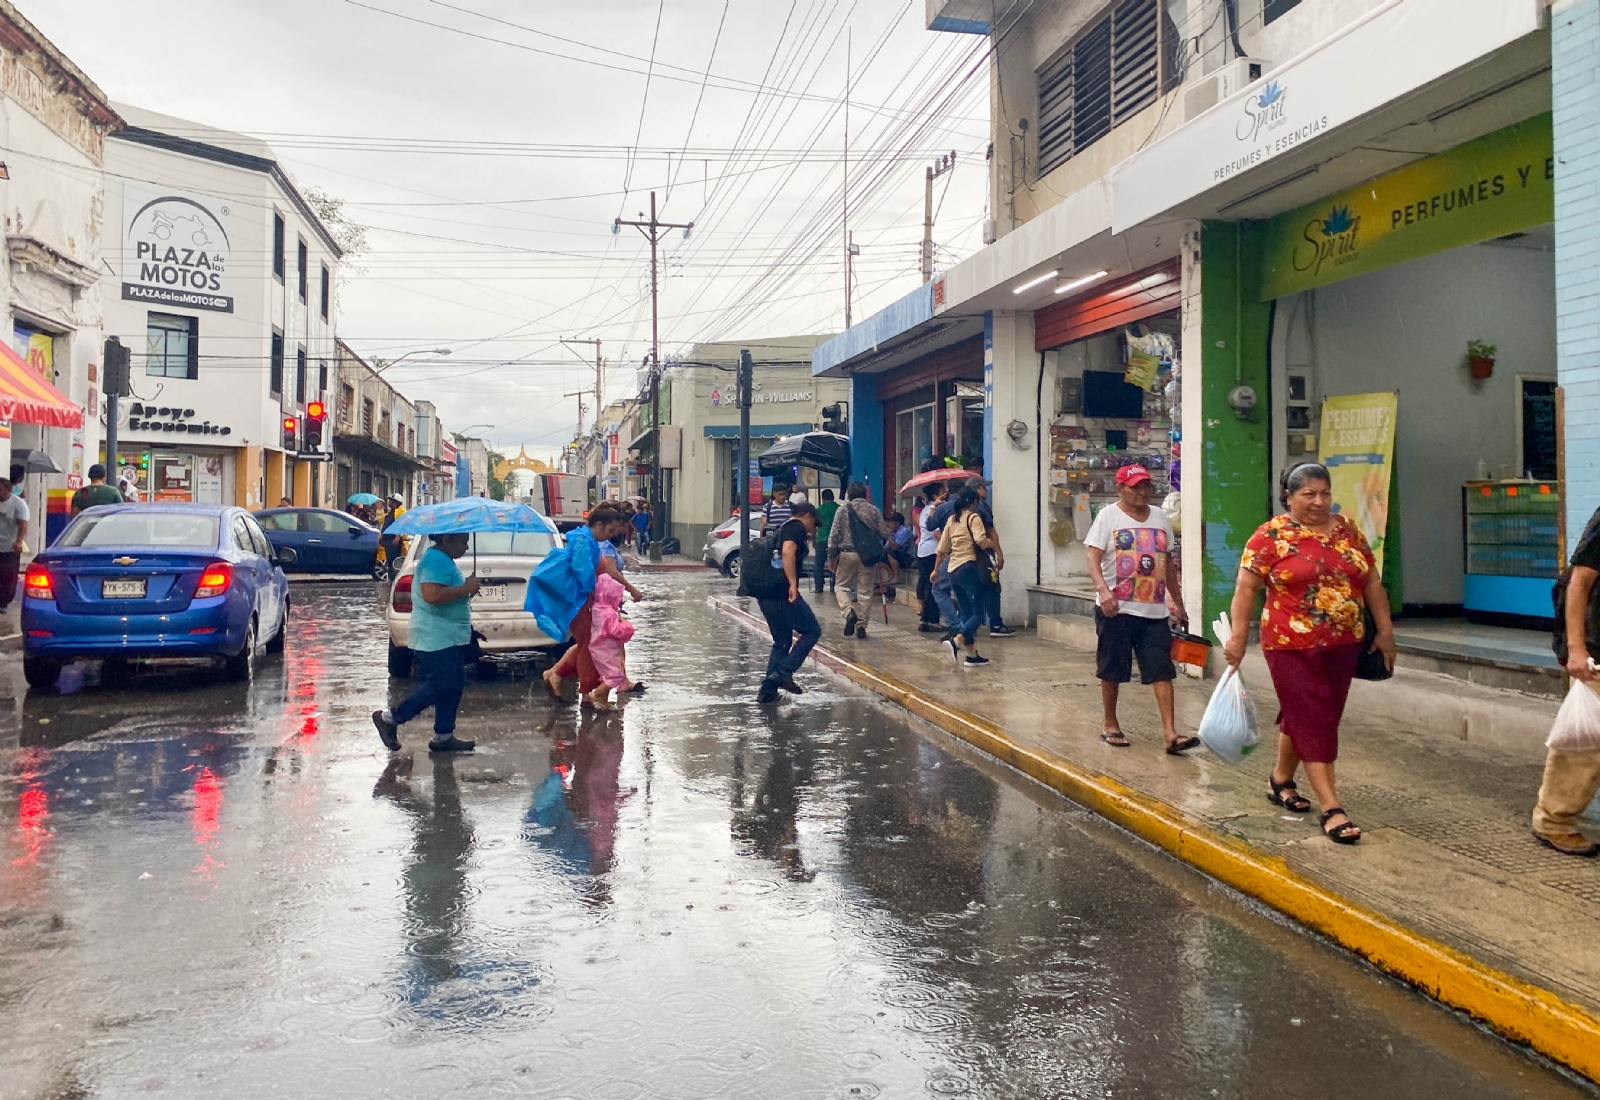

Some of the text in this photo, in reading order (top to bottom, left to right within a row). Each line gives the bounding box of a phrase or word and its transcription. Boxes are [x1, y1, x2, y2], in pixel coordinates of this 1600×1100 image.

[1214, 149, 1262, 181] PERFUMES
[1265, 144, 1272, 156] Y
[1275, 116, 1328, 152] ESENCIAS
[1391, 174, 1505, 229] PERFUMES
[1517, 164, 1531, 188] Y
[137, 240, 212, 270] PLAZA
[1292, 215, 1361, 277] Spirit
[212, 262, 225, 272] las
[213, 254, 225, 263] de
[140, 262, 221, 291] MOTOS
[129, 402, 196, 421] Apoyo
[129, 417, 232, 436] Económico
[1328, 430, 1337, 448] &
